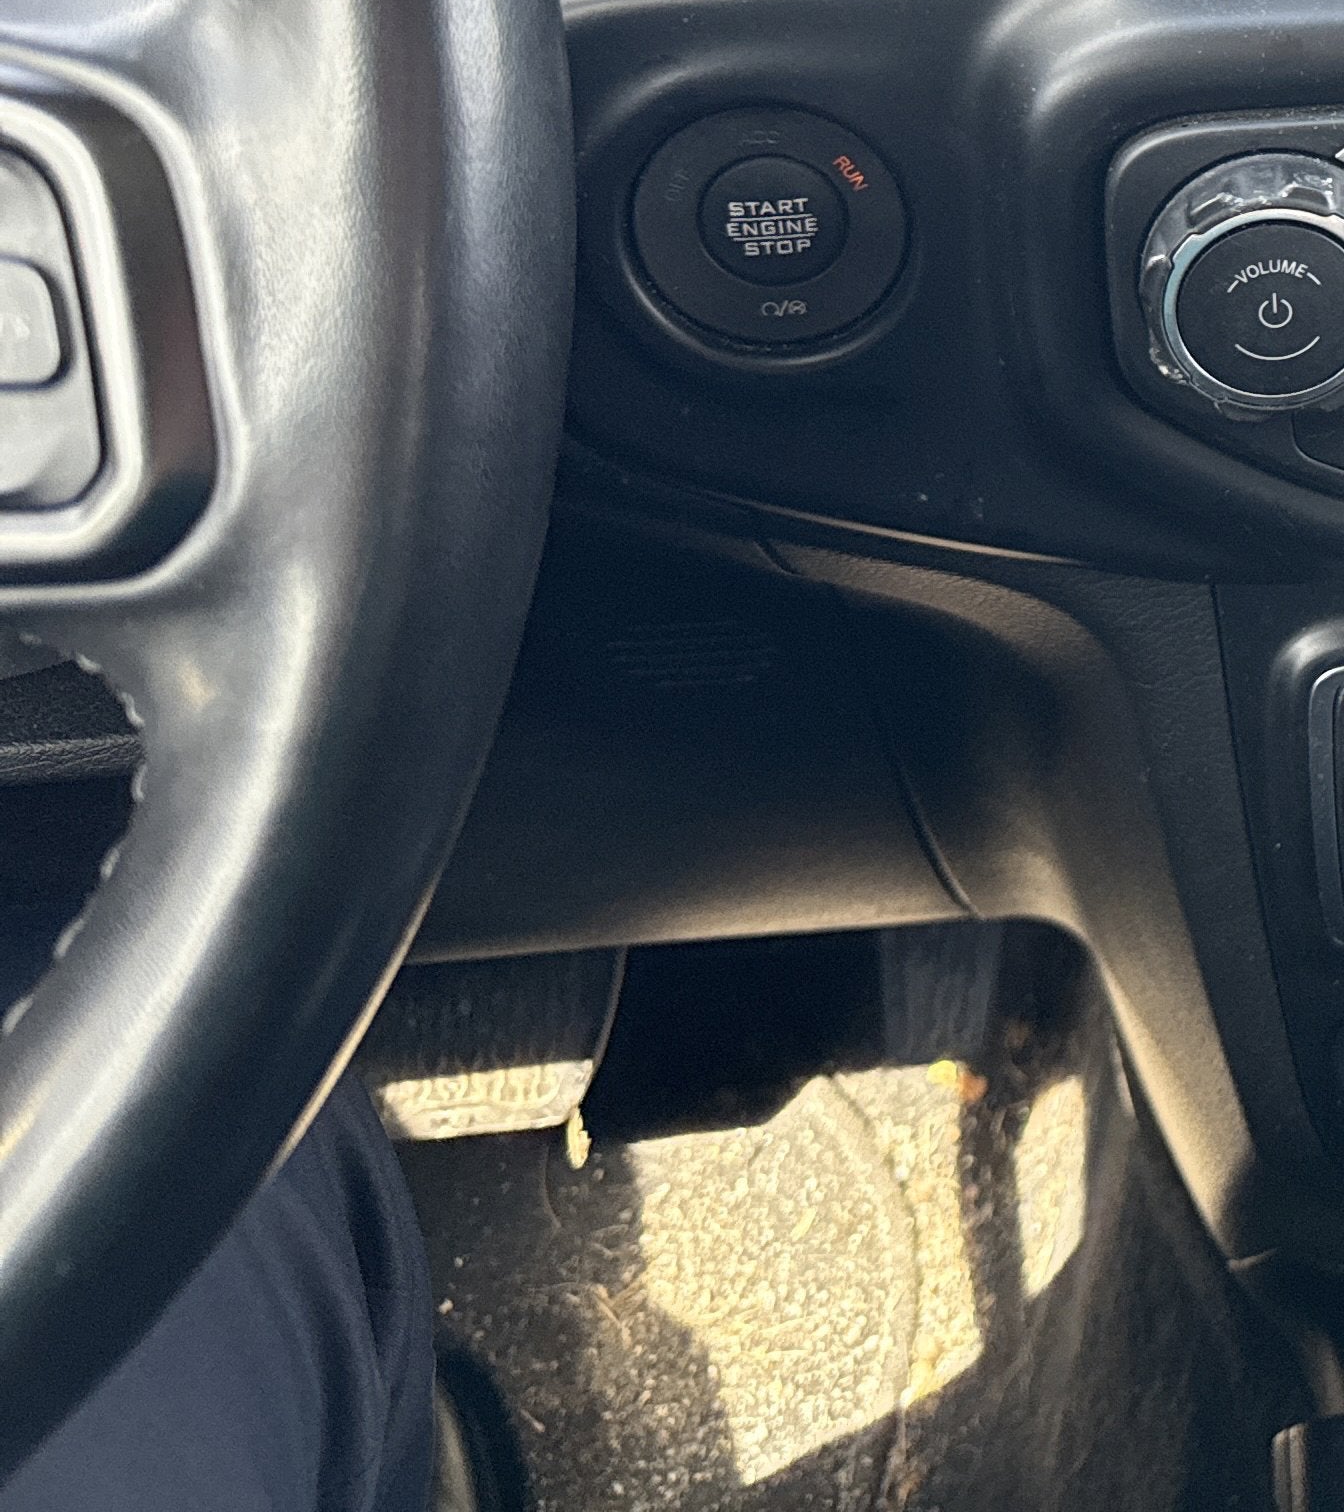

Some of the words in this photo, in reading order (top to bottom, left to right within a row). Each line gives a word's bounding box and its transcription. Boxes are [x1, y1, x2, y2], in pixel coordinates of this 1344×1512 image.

[833, 155, 869, 193] RUN
[728, 198, 808, 216] START
[726, 217, 819, 236] ENGINE
[744, 239, 811, 256] STOP
[1234, 259, 1308, 283] VOLUME
